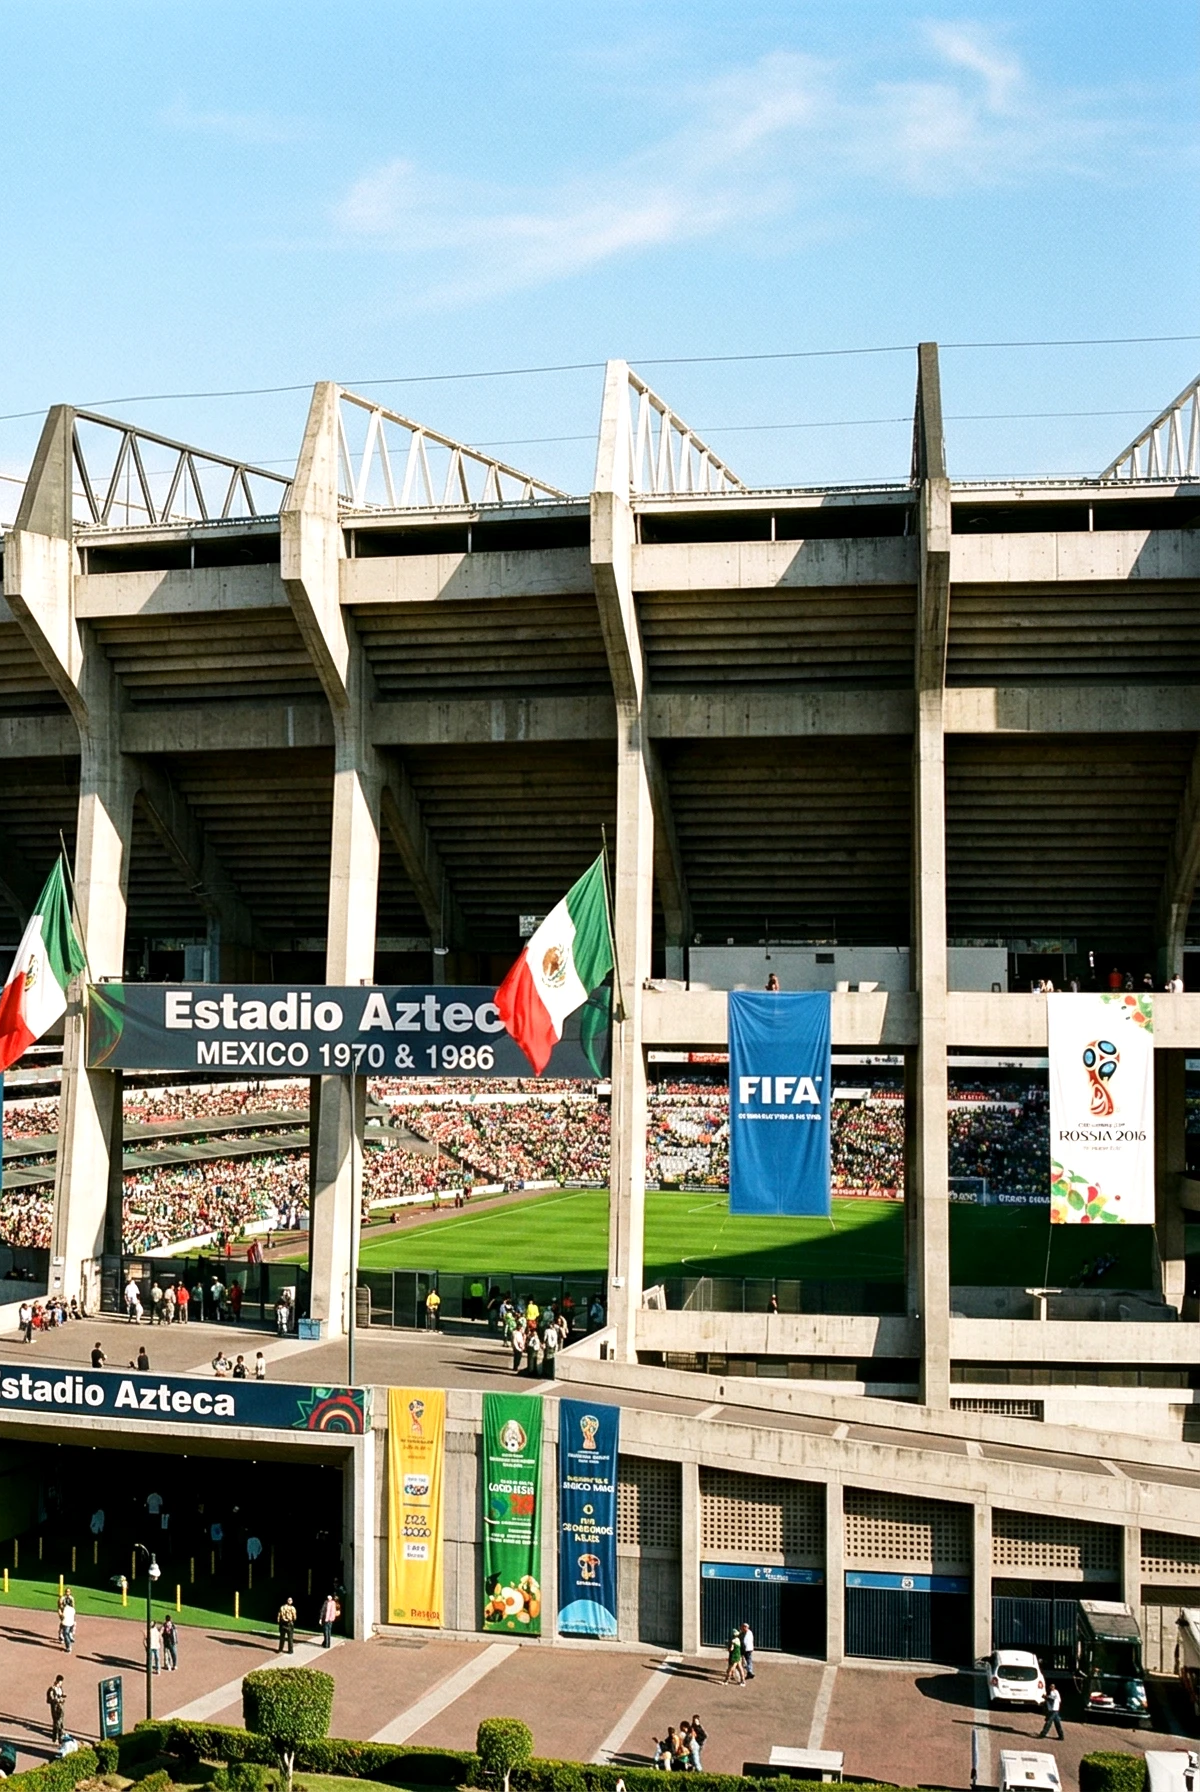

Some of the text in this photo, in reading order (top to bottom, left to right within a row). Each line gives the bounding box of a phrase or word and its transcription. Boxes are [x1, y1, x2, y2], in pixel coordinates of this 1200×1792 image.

[164, 991, 506, 1034] Estadio Aztec
[196, 1041, 494, 1070] MEXICO 1970 & 1986
[738, 1076, 821, 1105] FIFA
[114, 1379, 236, 1417] Azteca
